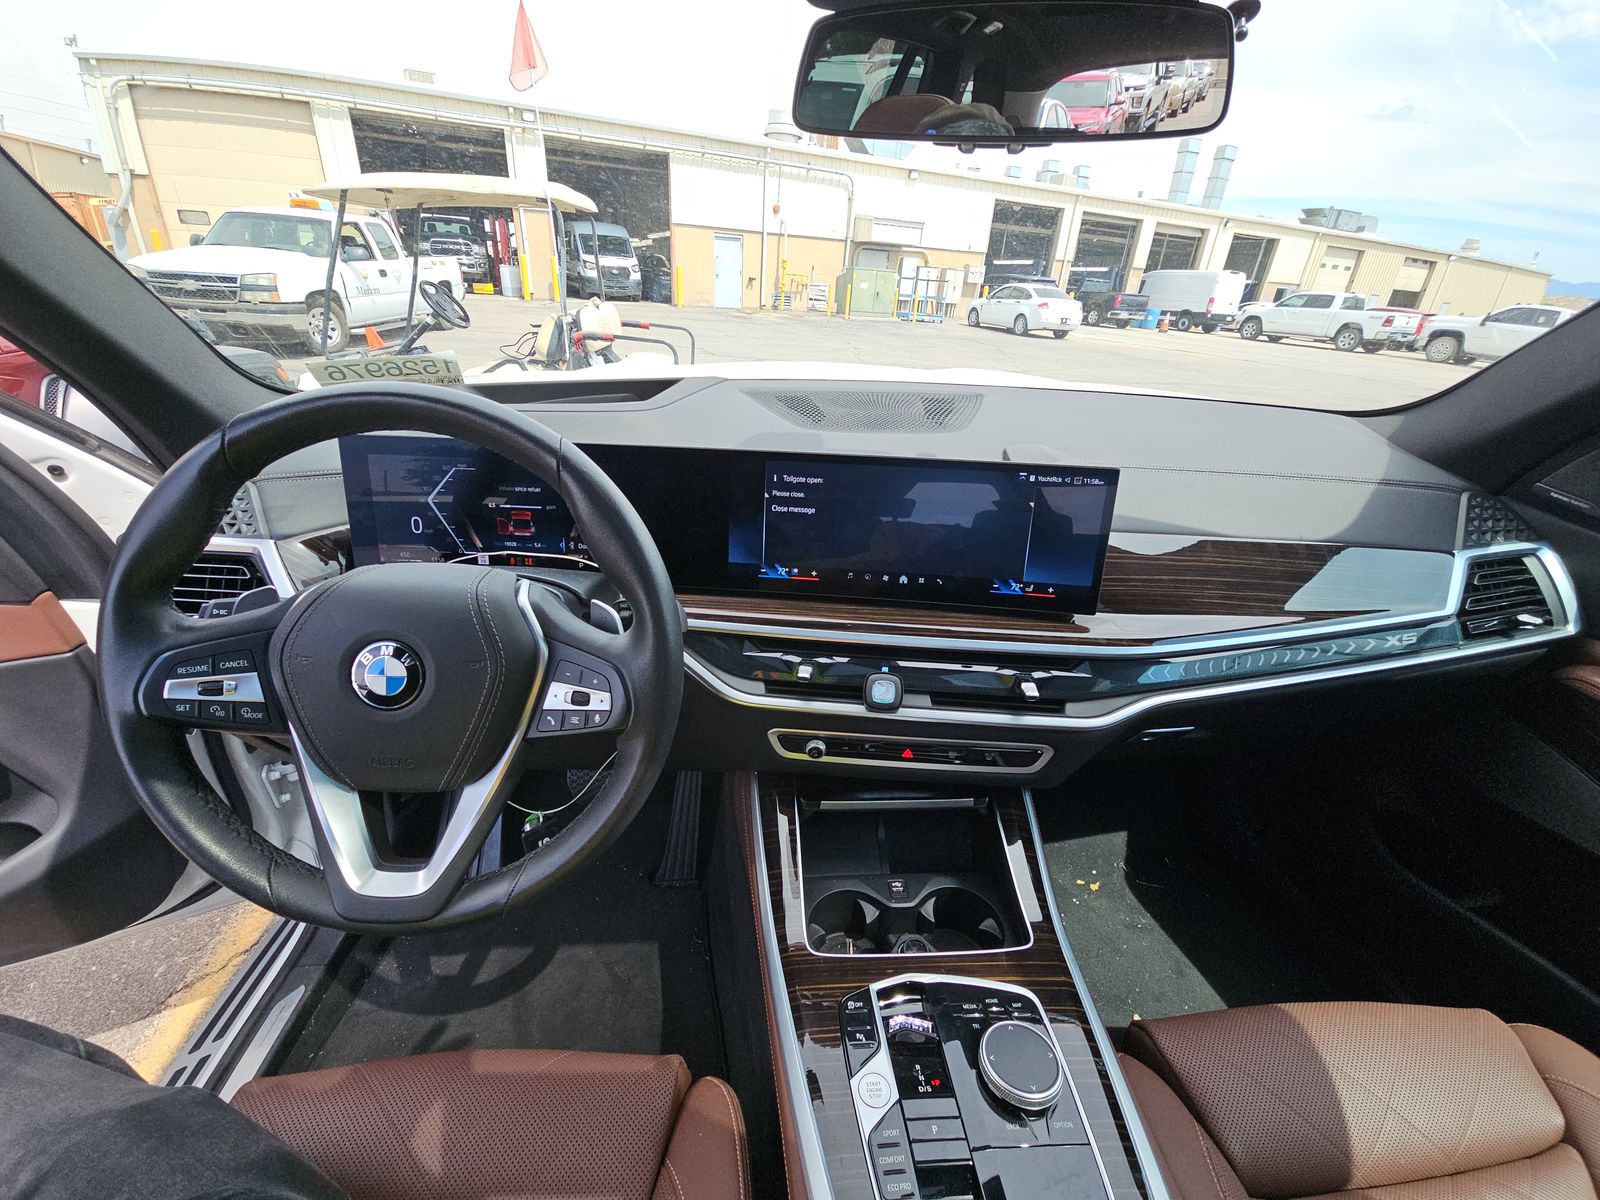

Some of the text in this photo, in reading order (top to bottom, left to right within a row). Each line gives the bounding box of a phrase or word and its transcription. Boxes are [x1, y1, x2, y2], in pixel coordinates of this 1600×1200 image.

[782, 475, 806, 483] Tailgate
[771, 504, 816, 515] Close message
[411, 516, 423, 534] 0
[361, 646, 416, 667] BMW
[177, 664, 209, 675] RESUME
[219, 659, 250, 670] CANCEL
[175, 704, 191, 712] SET
[882, 1129, 901, 1138] SPORT
[879, 1155, 906, 1165] COMFORT
[887, 1182, 912, 1192] ECO PRO
